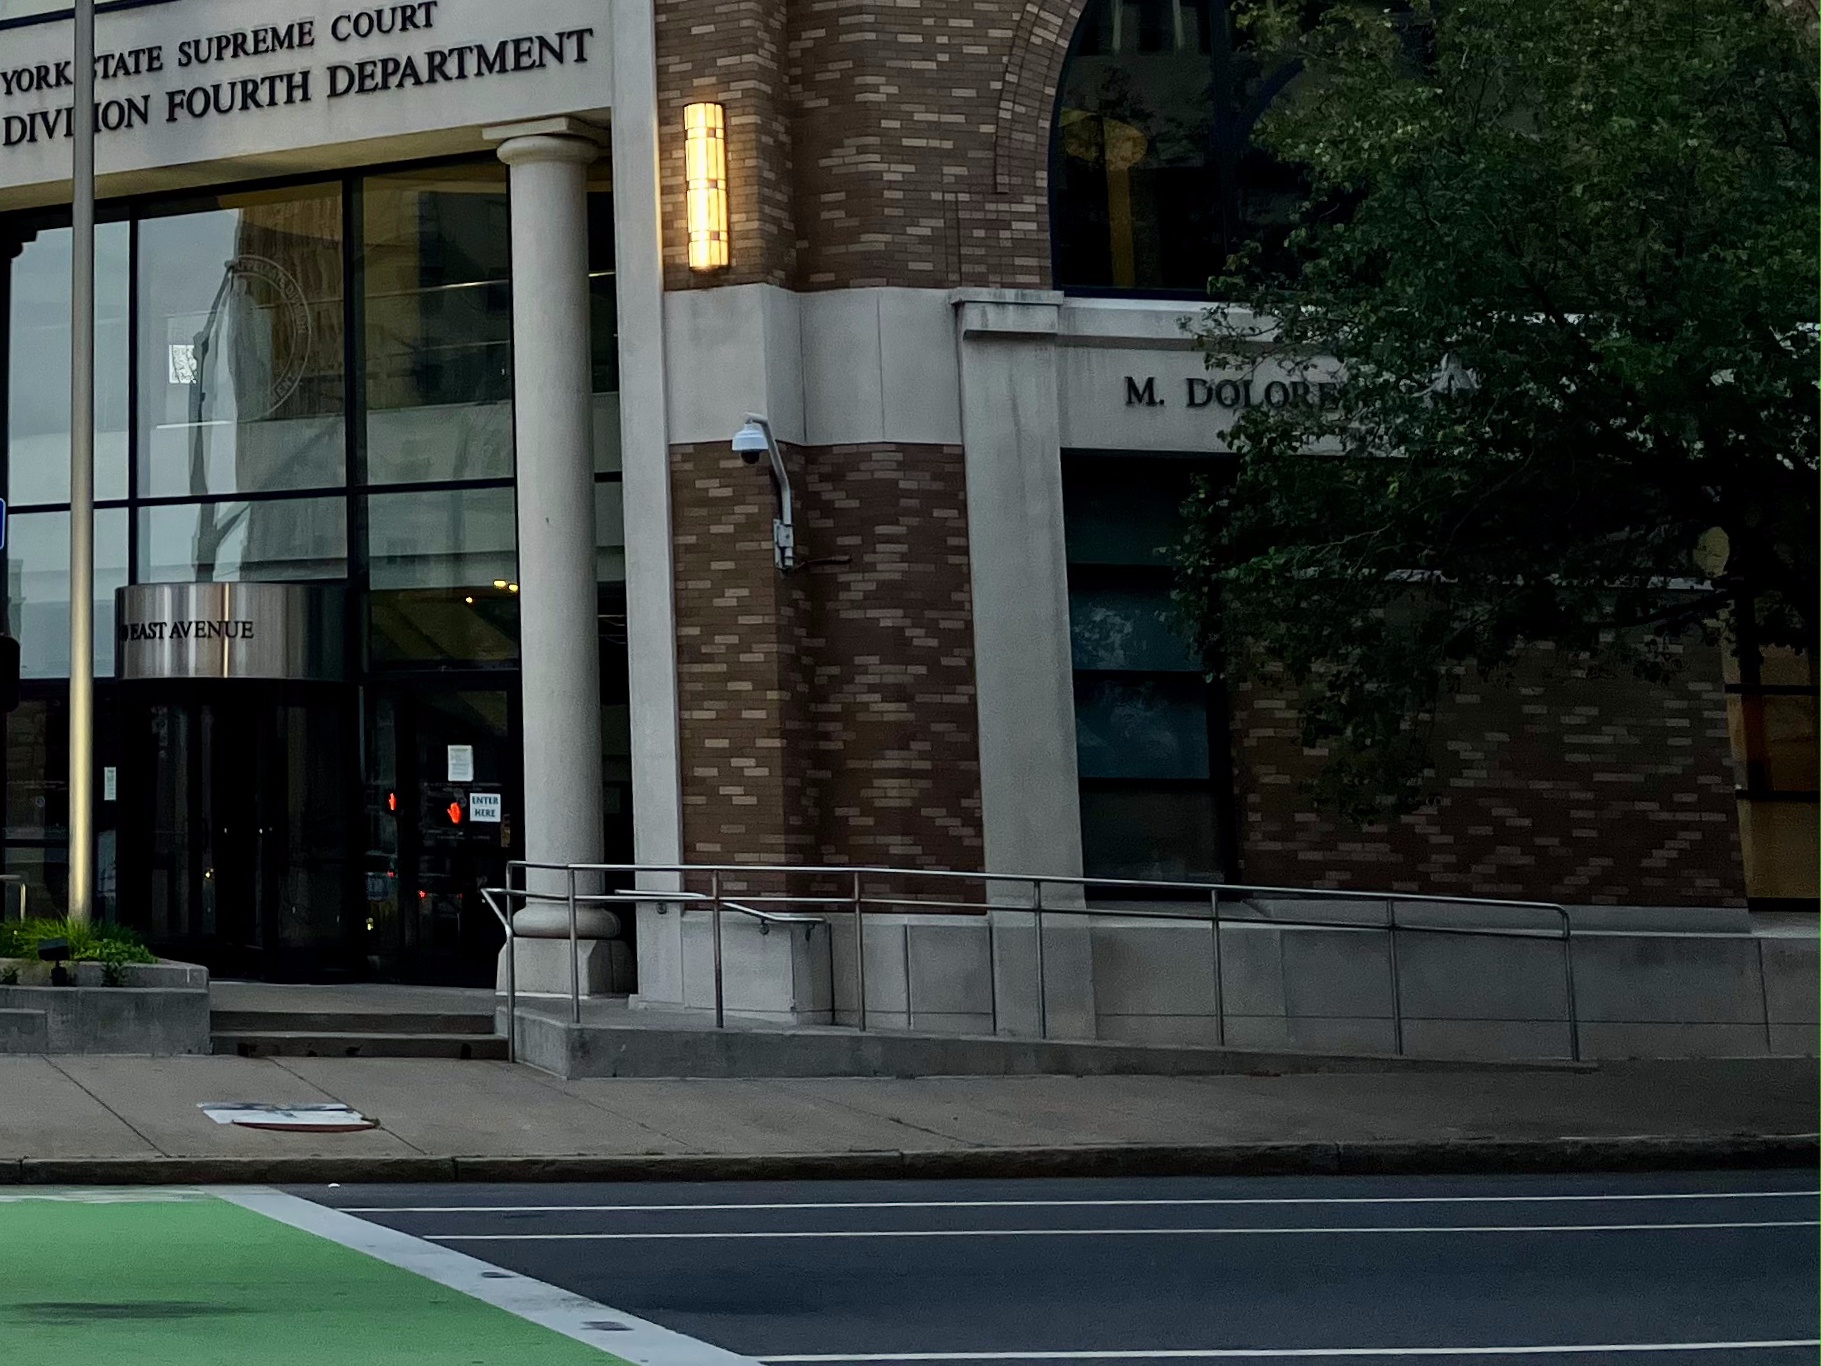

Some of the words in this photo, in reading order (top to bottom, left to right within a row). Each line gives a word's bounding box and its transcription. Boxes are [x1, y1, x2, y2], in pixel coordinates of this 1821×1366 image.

[0, 61, 73, 96] YORK
[178, 20, 315, 67] SUPREME
[331, 0, 438, 41] COURT
[2, 94, 150, 147] DIVIION
[166, 70, 311, 122] FOURTH
[326, 27, 593, 99] DEPARTMENT
[1124, 376, 1165, 407] M.
[128, 621, 167, 641] EAST
[169, 620, 255, 639] AVENUE
[472, 796, 499, 805] ENTER
[474, 809, 496, 818] HERE
